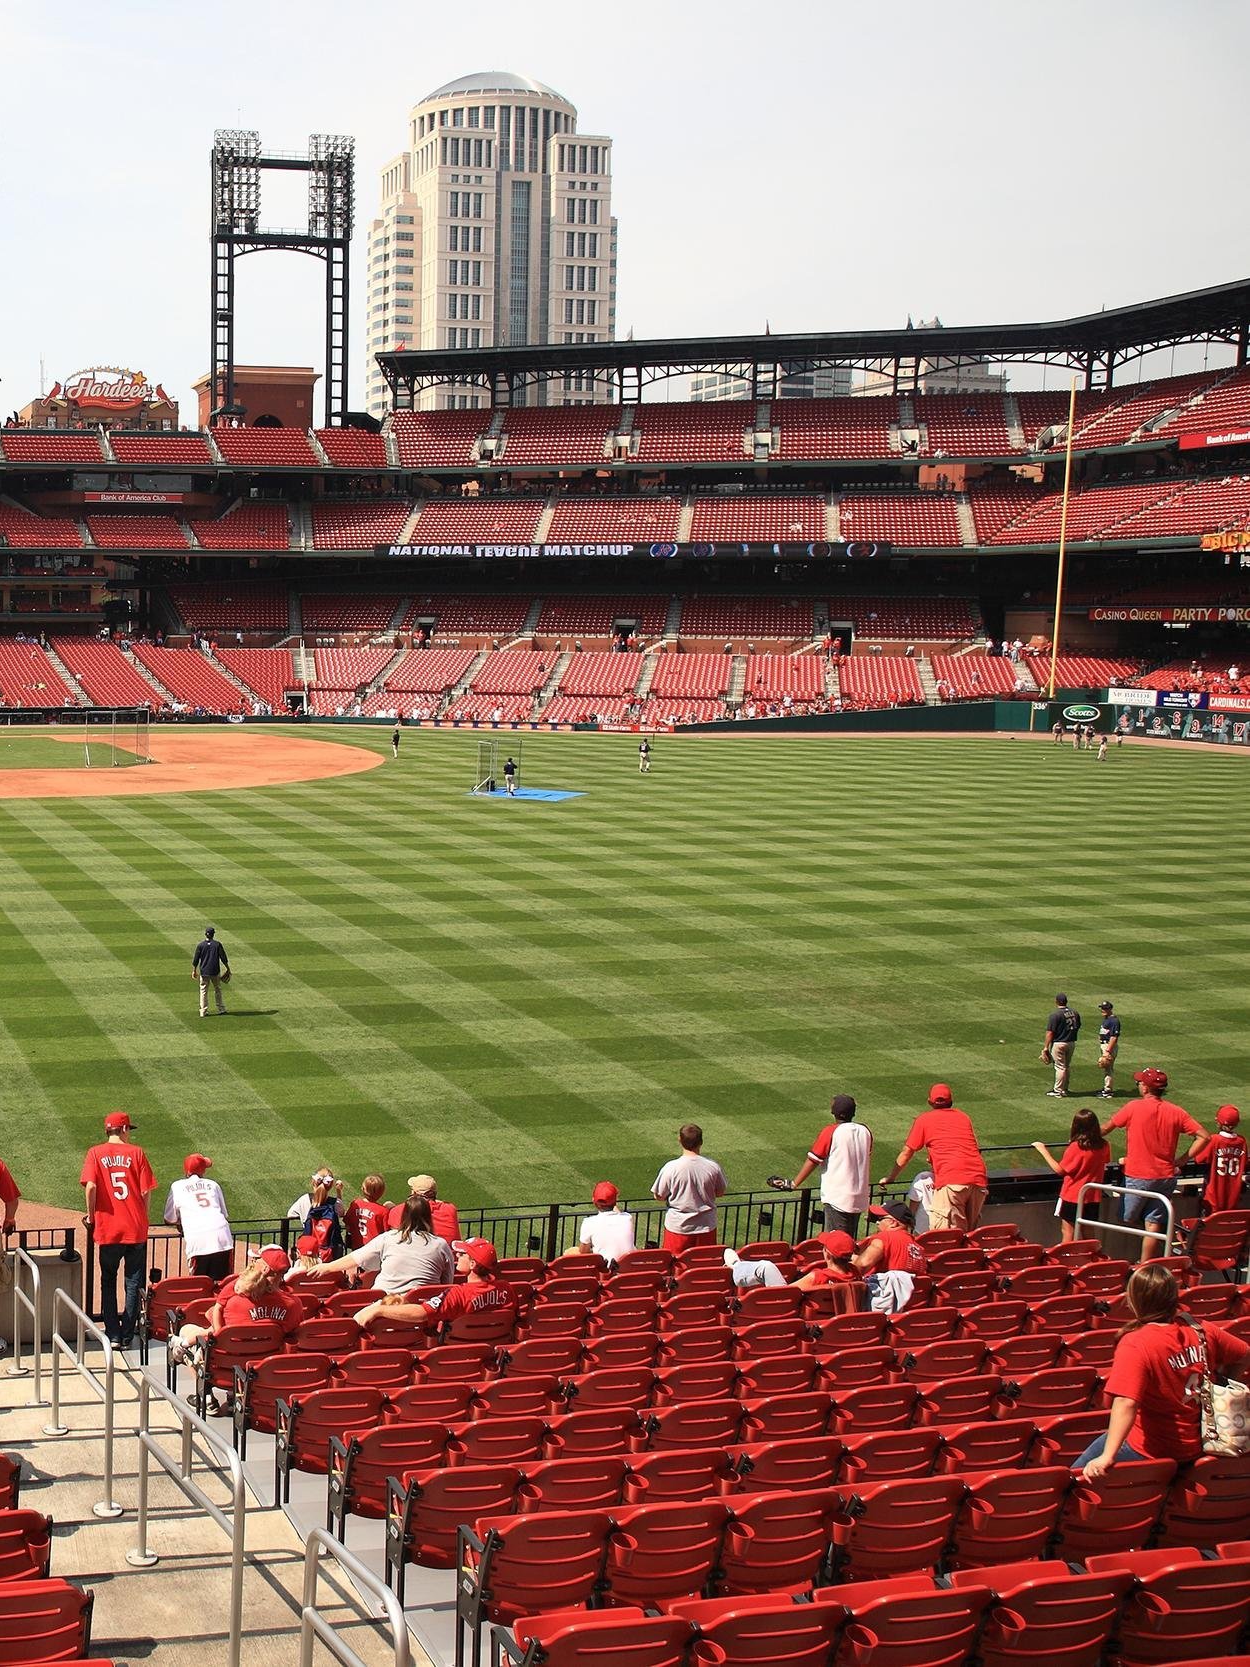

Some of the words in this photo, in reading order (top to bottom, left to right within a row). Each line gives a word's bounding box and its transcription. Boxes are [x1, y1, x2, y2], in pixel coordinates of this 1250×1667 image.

[1206, 435, 1223, 445] Bank
[388, 545, 472, 556] NATIONAL
[544, 544, 634, 556] MATCHUP
[1172, 608, 1213, 621] PARTY
[1068, 708, 1096, 717] Scotts
[1172, 711, 1181, 725] 6
[1152, 717, 1161, 730] 2
[1191, 719, 1200, 733] 9
[1212, 713, 1224, 728] 14
[1233, 722, 1246, 737] 17
[100, 1155, 132, 1169] PUJOLS
[1216, 1157, 1240, 1176] 50
[110, 1171, 129, 1200] 5
[185, 1181, 211, 1193] PUJOLS
[195, 1193, 211, 1208] 5
[358, 1218, 368, 1237] 5
[471, 1289, 508, 1311] PUJOLS
[249, 1306, 287, 1321] MOLINA
